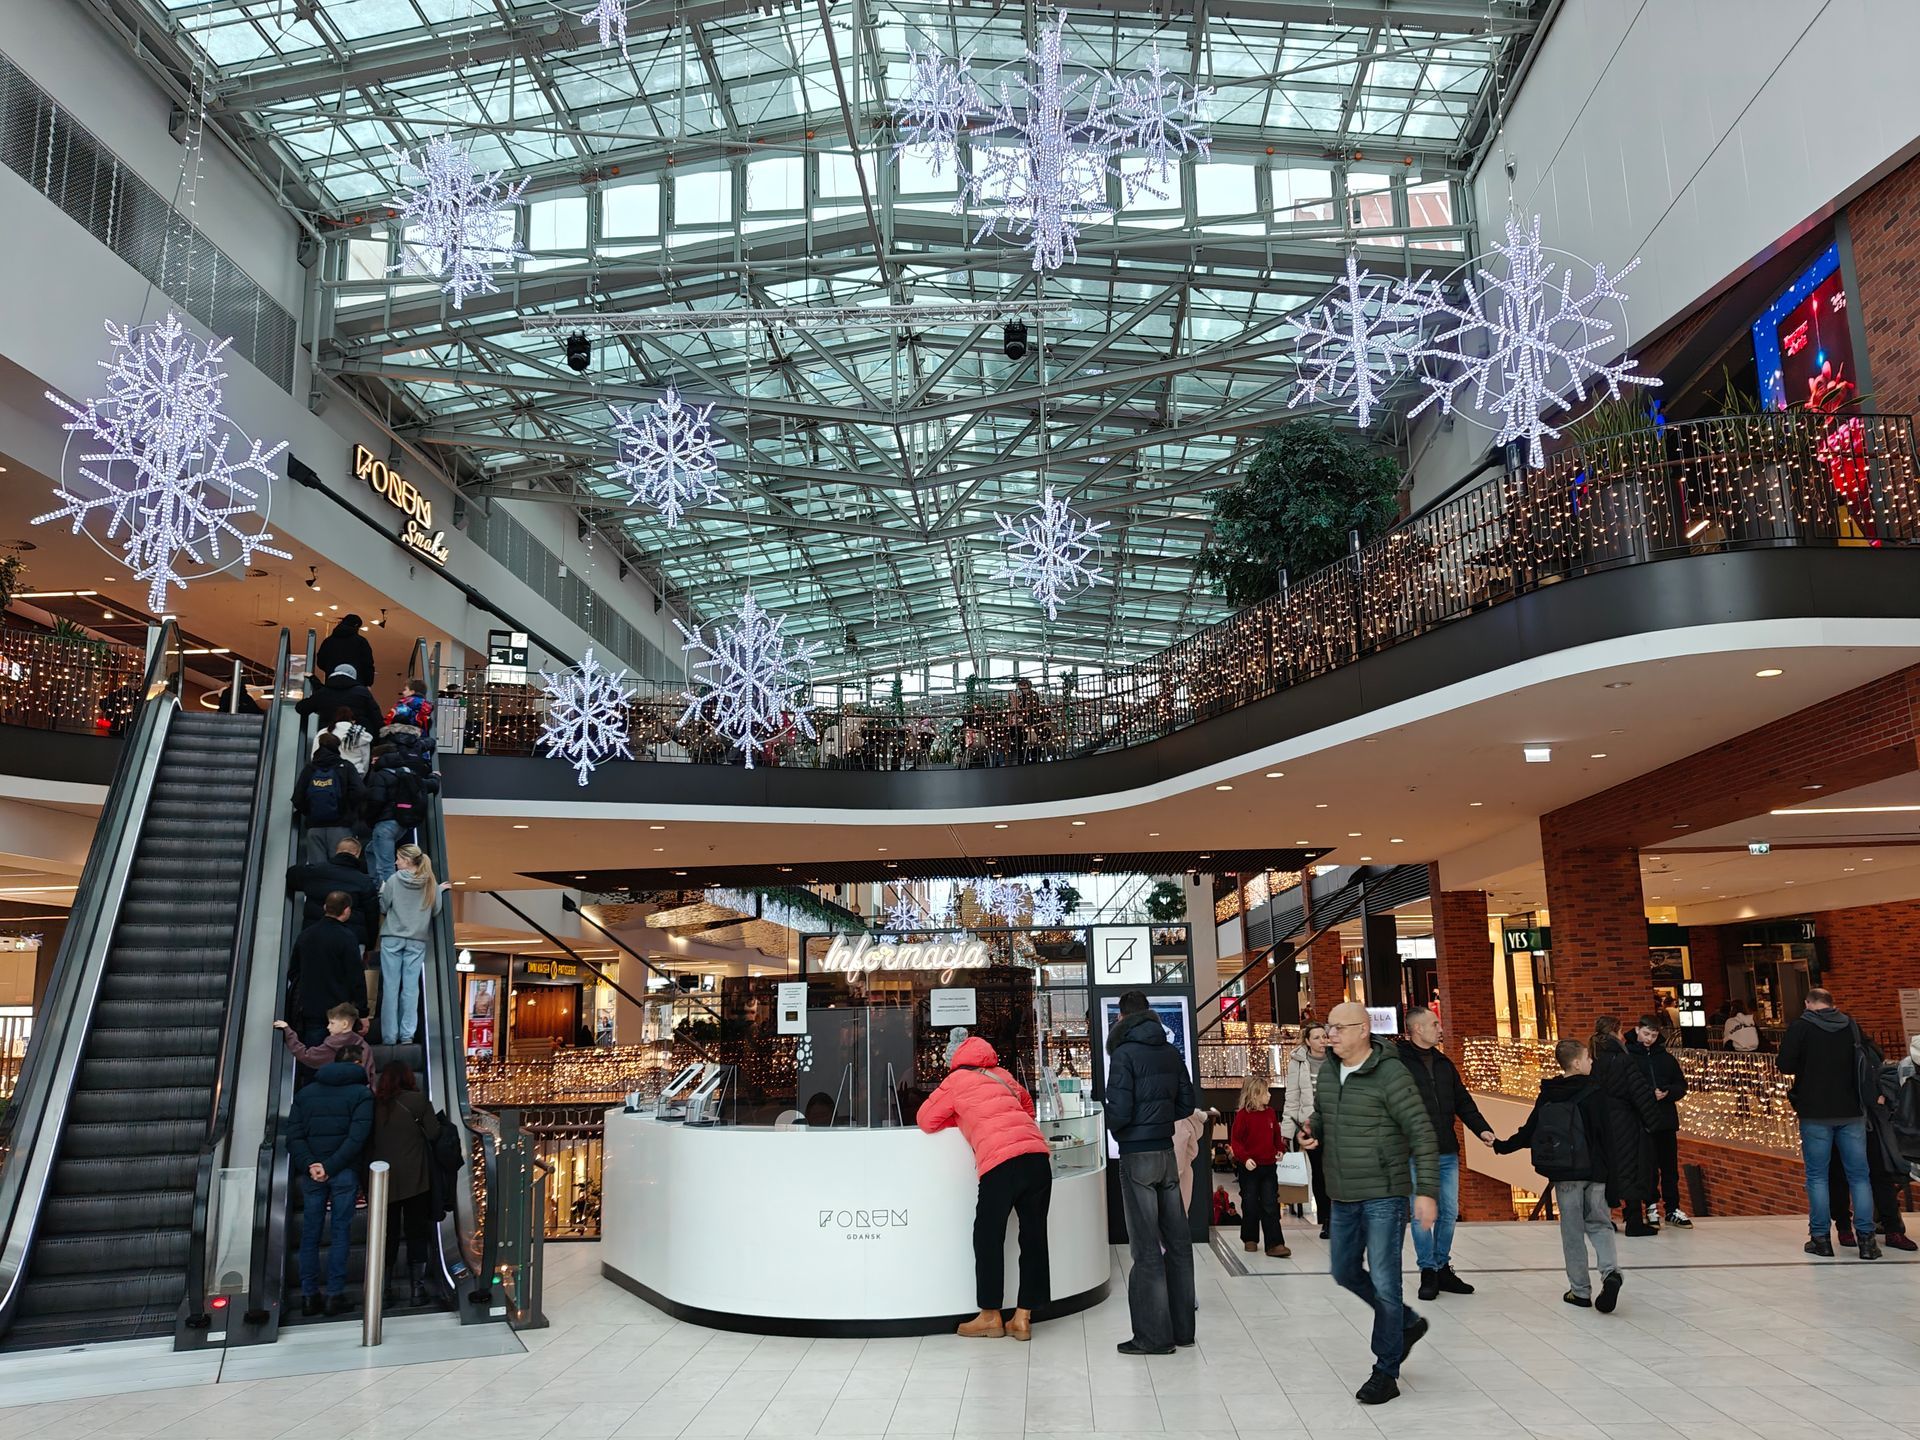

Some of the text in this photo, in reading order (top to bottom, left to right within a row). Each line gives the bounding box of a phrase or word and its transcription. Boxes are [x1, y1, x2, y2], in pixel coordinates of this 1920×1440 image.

[356, 444, 432, 530] FORUM
[401, 520, 450, 562] Smaku
[818, 939, 985, 984] Informacja
[1507, 932, 1528, 949] YES
[819, 1209, 908, 1228] FORUM
